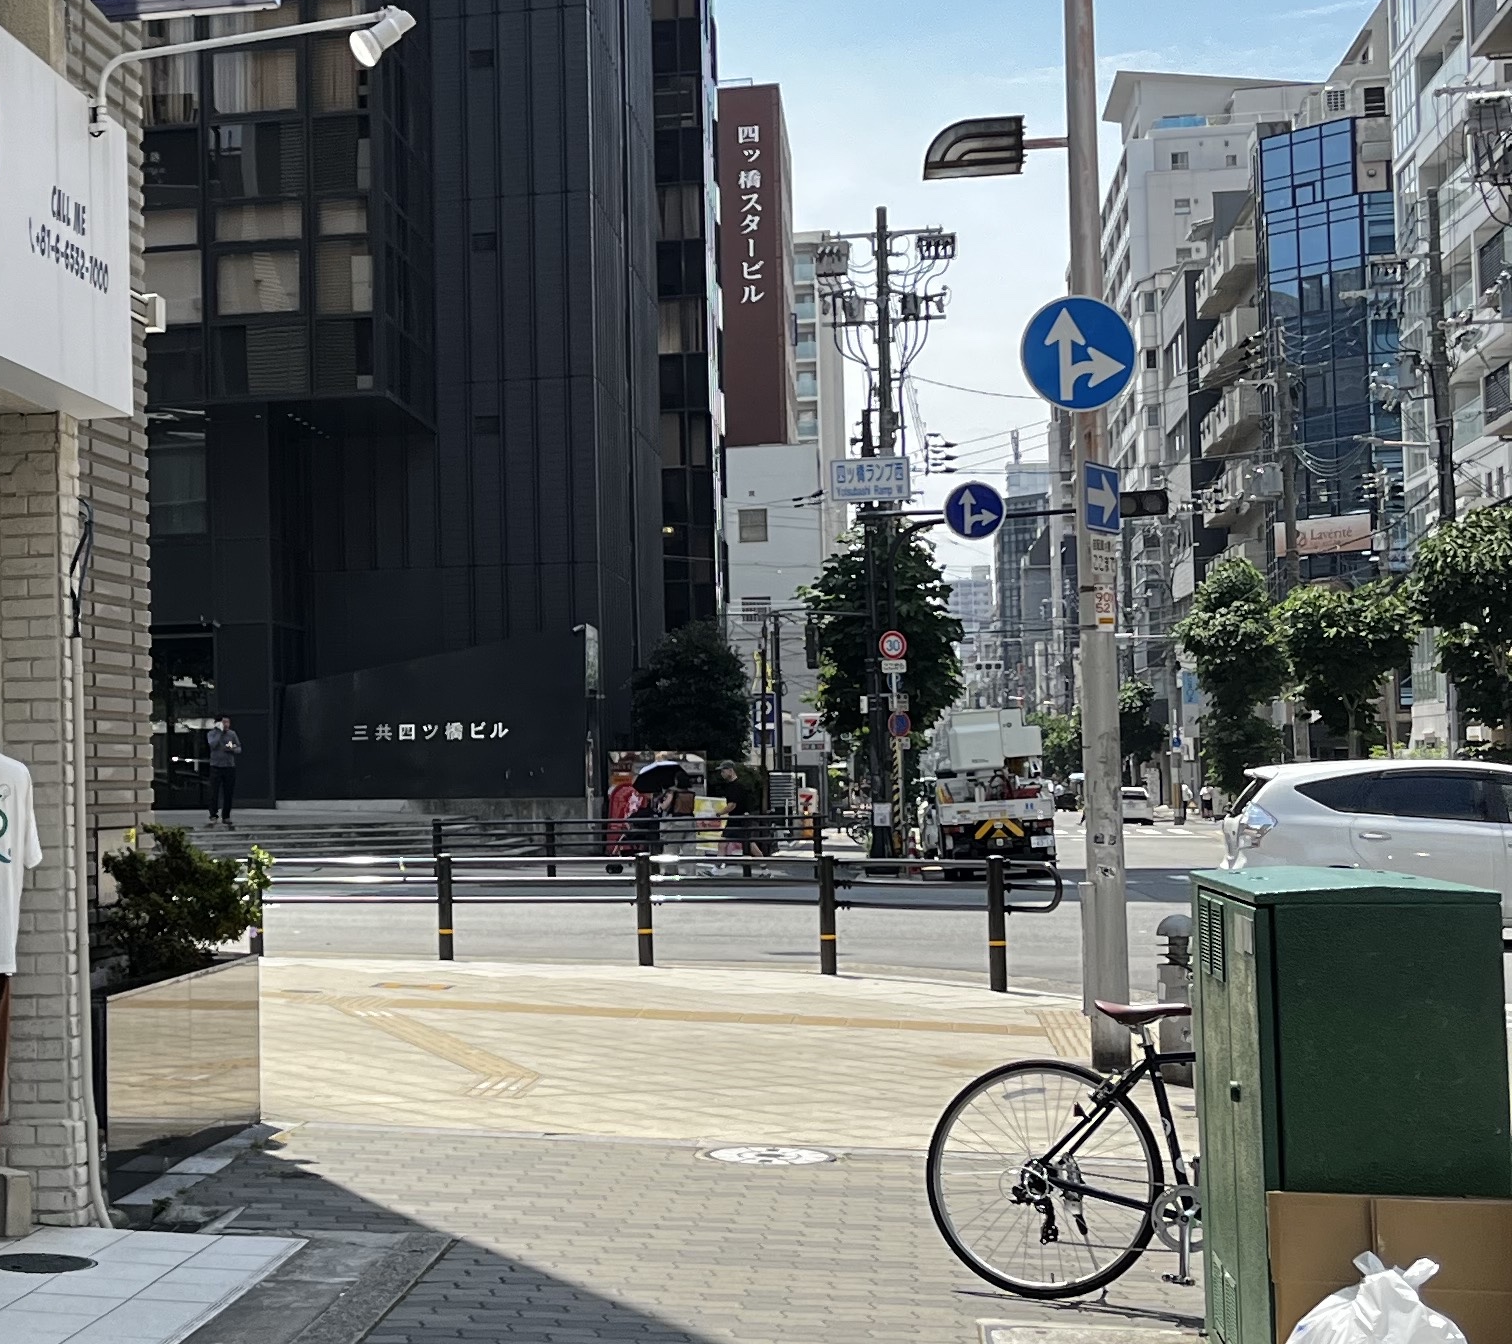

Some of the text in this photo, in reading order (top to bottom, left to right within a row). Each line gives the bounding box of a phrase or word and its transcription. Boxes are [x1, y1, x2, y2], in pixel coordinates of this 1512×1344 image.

[51, 185, 86, 237] CALL ME
[737, 124, 765, 305] 四ツ橋スタービル
[886, 639, 900, 652] 30
[351, 721, 509, 741] 三共四ツ橋ビル
